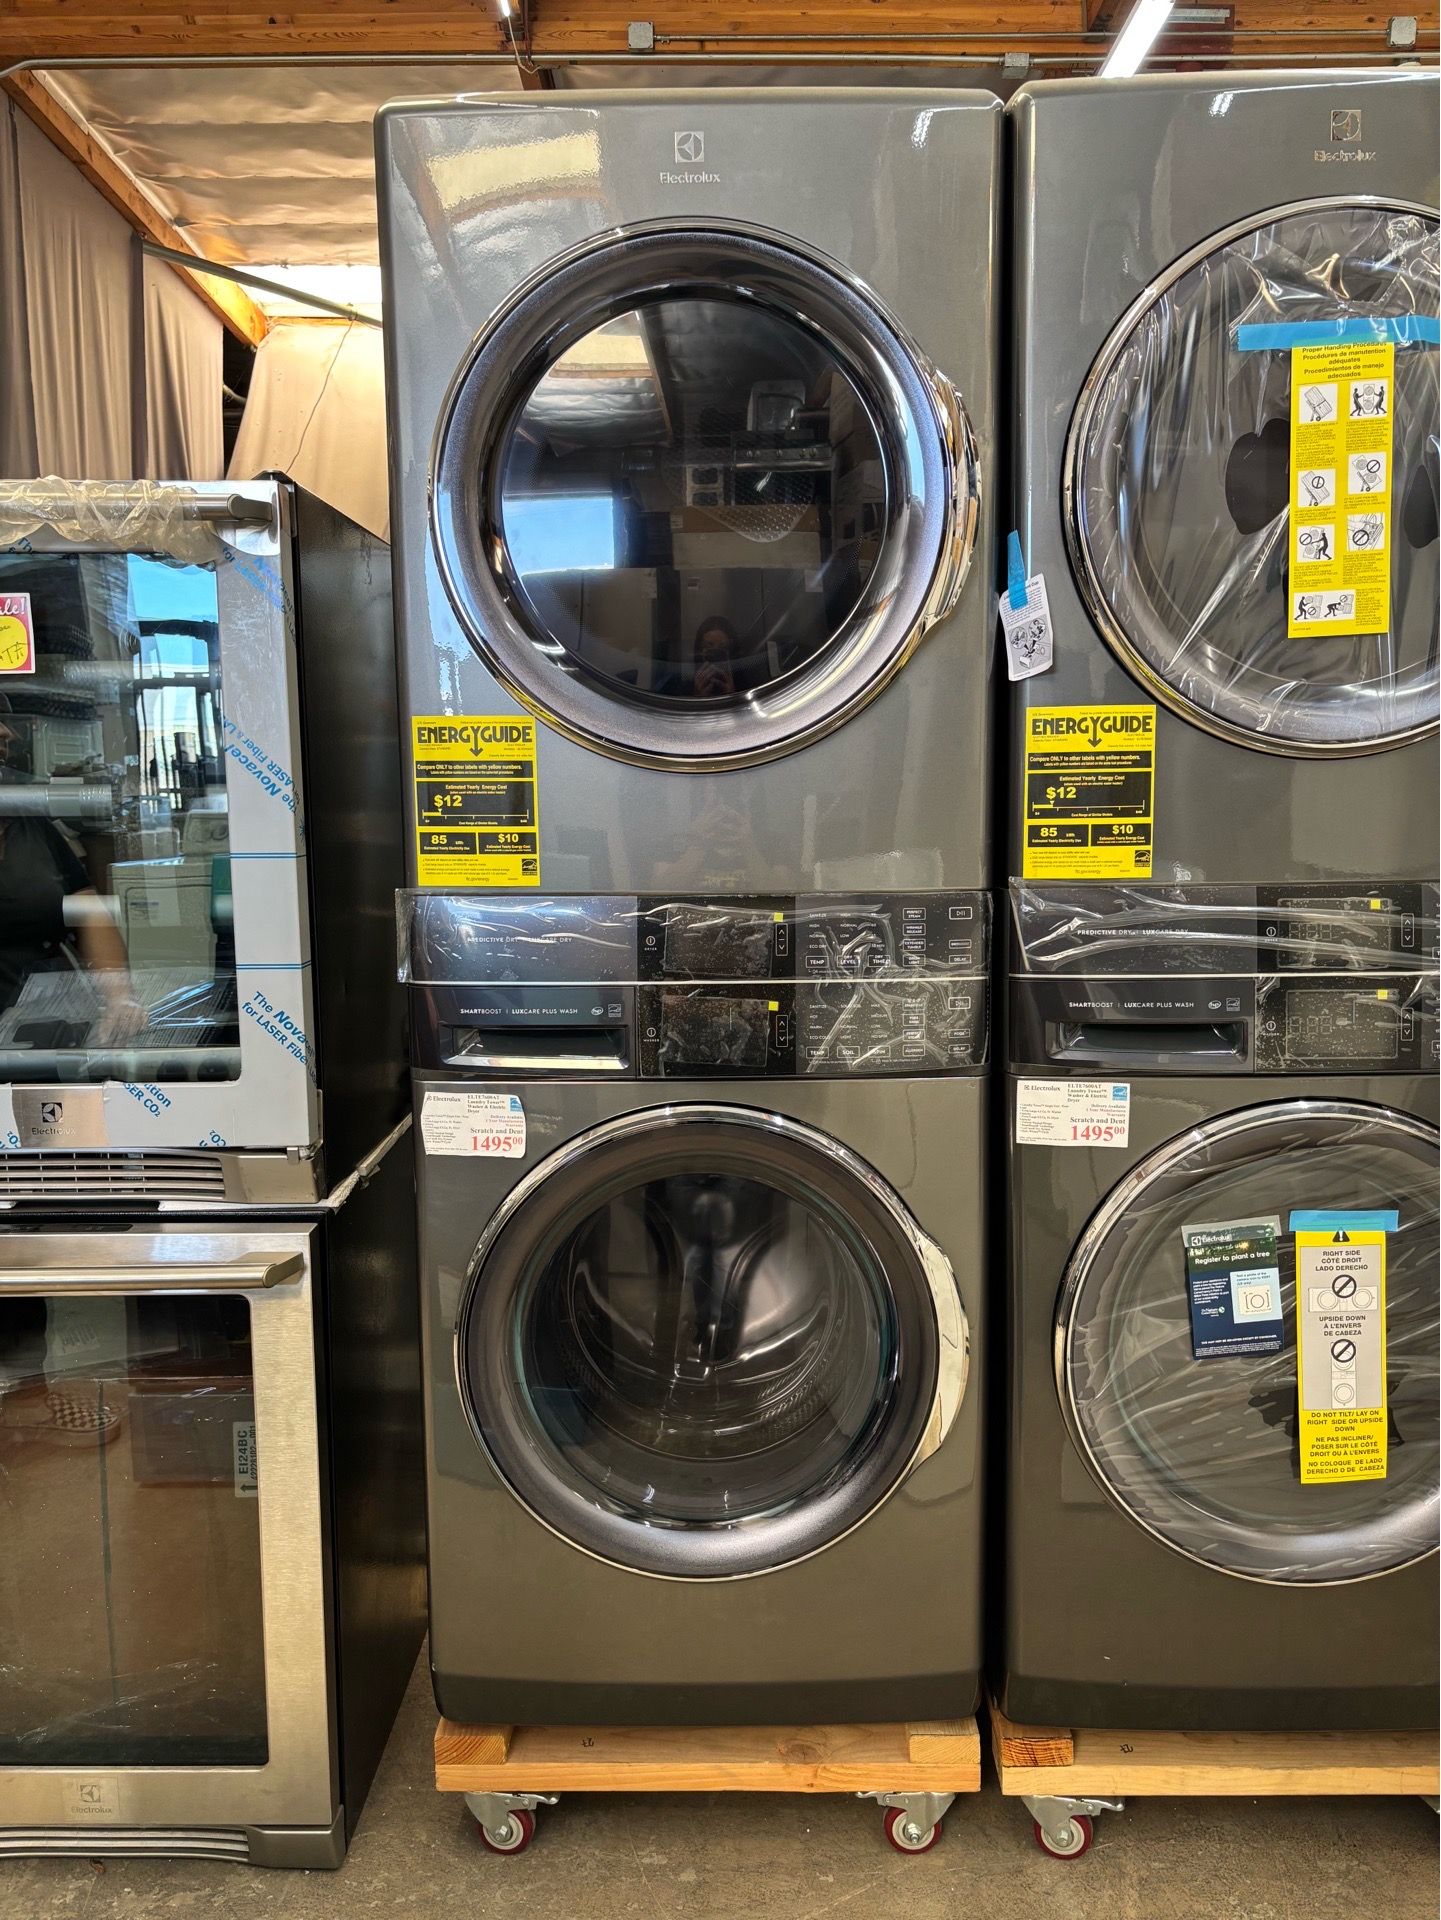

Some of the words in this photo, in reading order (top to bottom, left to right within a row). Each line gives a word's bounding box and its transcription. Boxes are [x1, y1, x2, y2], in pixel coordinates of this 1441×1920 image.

[1314, 150, 1376, 161] Electrolux
[660, 171, 720, 184] Electrolux
[1303, 352, 1337, 360] Procédures
[1304, 366, 1351, 374] Procedimientos
[0, 598, 25, 615] le!
[1032, 716, 1153, 735] ENERGYGUIDE
[417, 726, 532, 743] ENERGYGUIDE
[241, 738, 268, 763] Fiber
[224, 744, 282, 796] Novacel
[1046, 786, 1076, 800] $12
[434, 794, 462, 807] $12
[1040, 827, 1057, 837] 85
[1112, 825, 1134, 835] $10
[431, 834, 447, 844] 85
[498, 833, 518, 843] $10
[253, 991, 273, 1013] The
[242, 1002, 258, 1017] for
[256, 1015, 288, 1045] LASER
[31, 1127, 76, 1135] Electrolux
[1071, 1125, 1114, 1141] 1495
[472, 1136, 512, 1152] 1495
[1195, 1255, 1221, 1265] Register
[1231, 1252, 1248, 1262] plant
[237, 1430, 248, 1474] EI24BC
